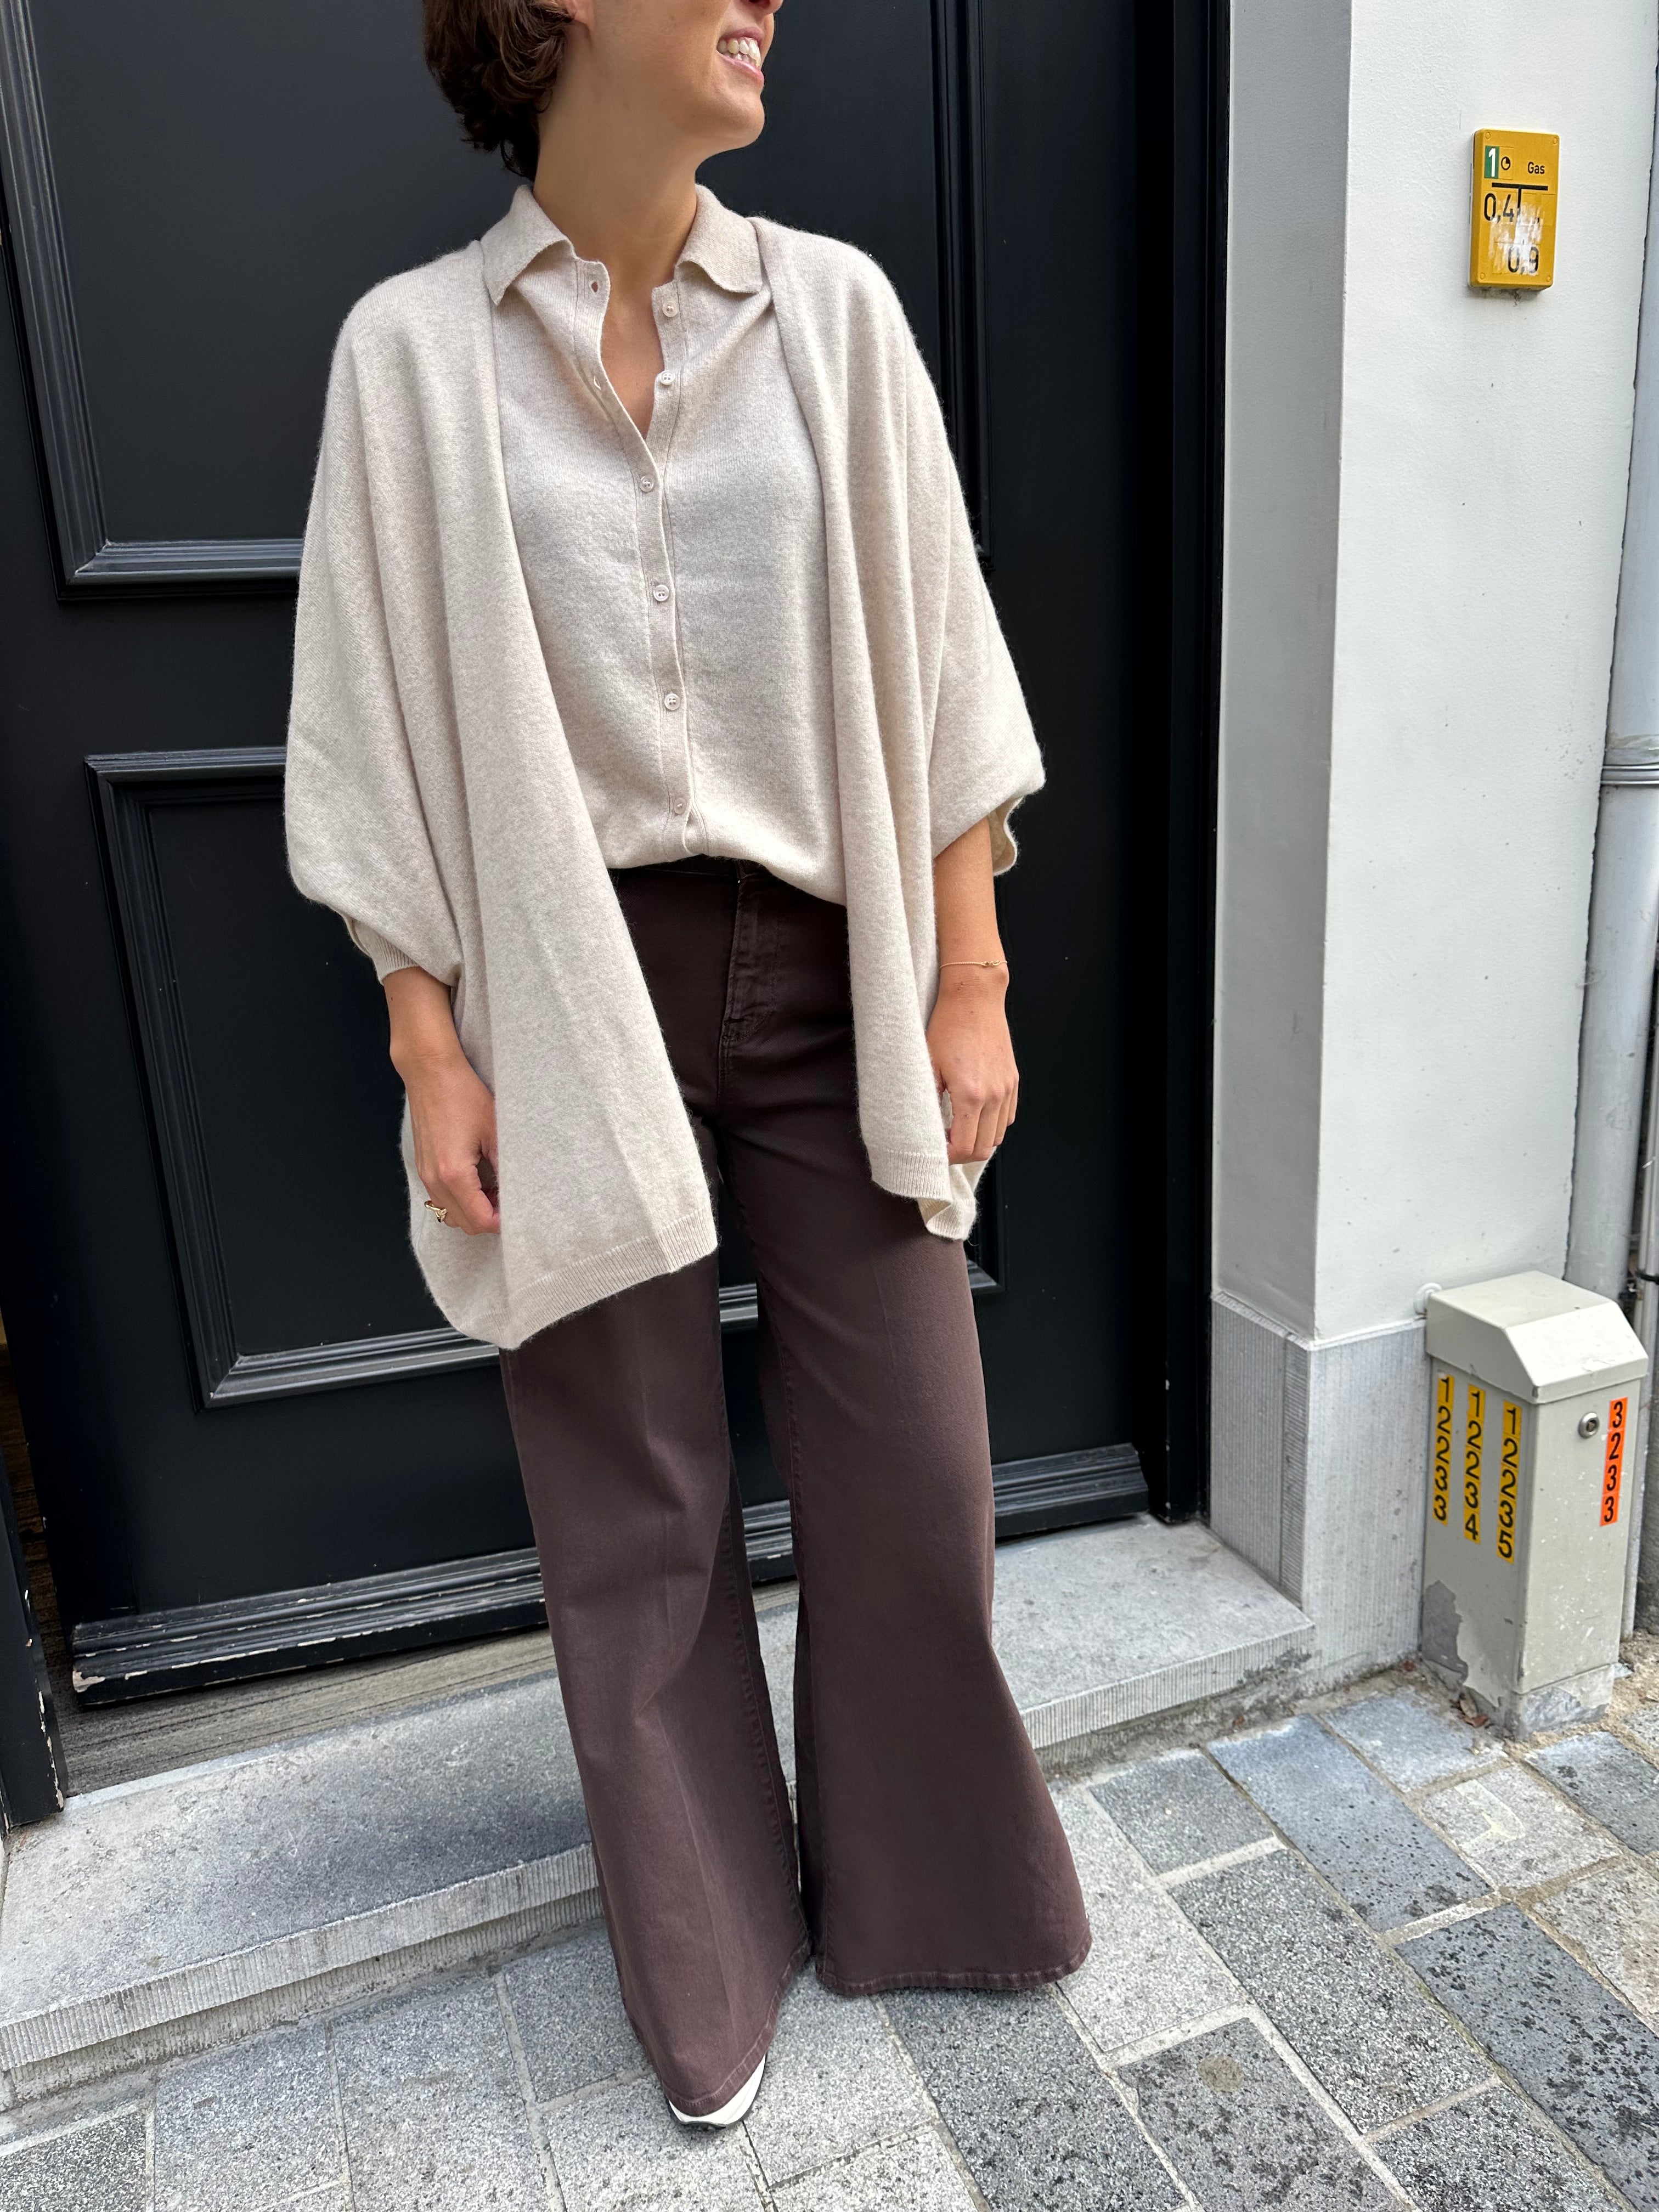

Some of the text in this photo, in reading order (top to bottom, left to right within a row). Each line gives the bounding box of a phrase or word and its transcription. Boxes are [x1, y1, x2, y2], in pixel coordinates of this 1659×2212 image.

[1488, 148, 1496, 177] 1
[1527, 161, 1545, 174] Gas
[1483, 193, 1514, 224] 0,4
[1508, 246, 1539, 275] 0,9
[1434, 1377, 1450, 1521] 12233
[1464, 1390, 1481, 1541] 12234
[1497, 1407, 1517, 1559] 12235
[1604, 1401, 1623, 1522] 3233
